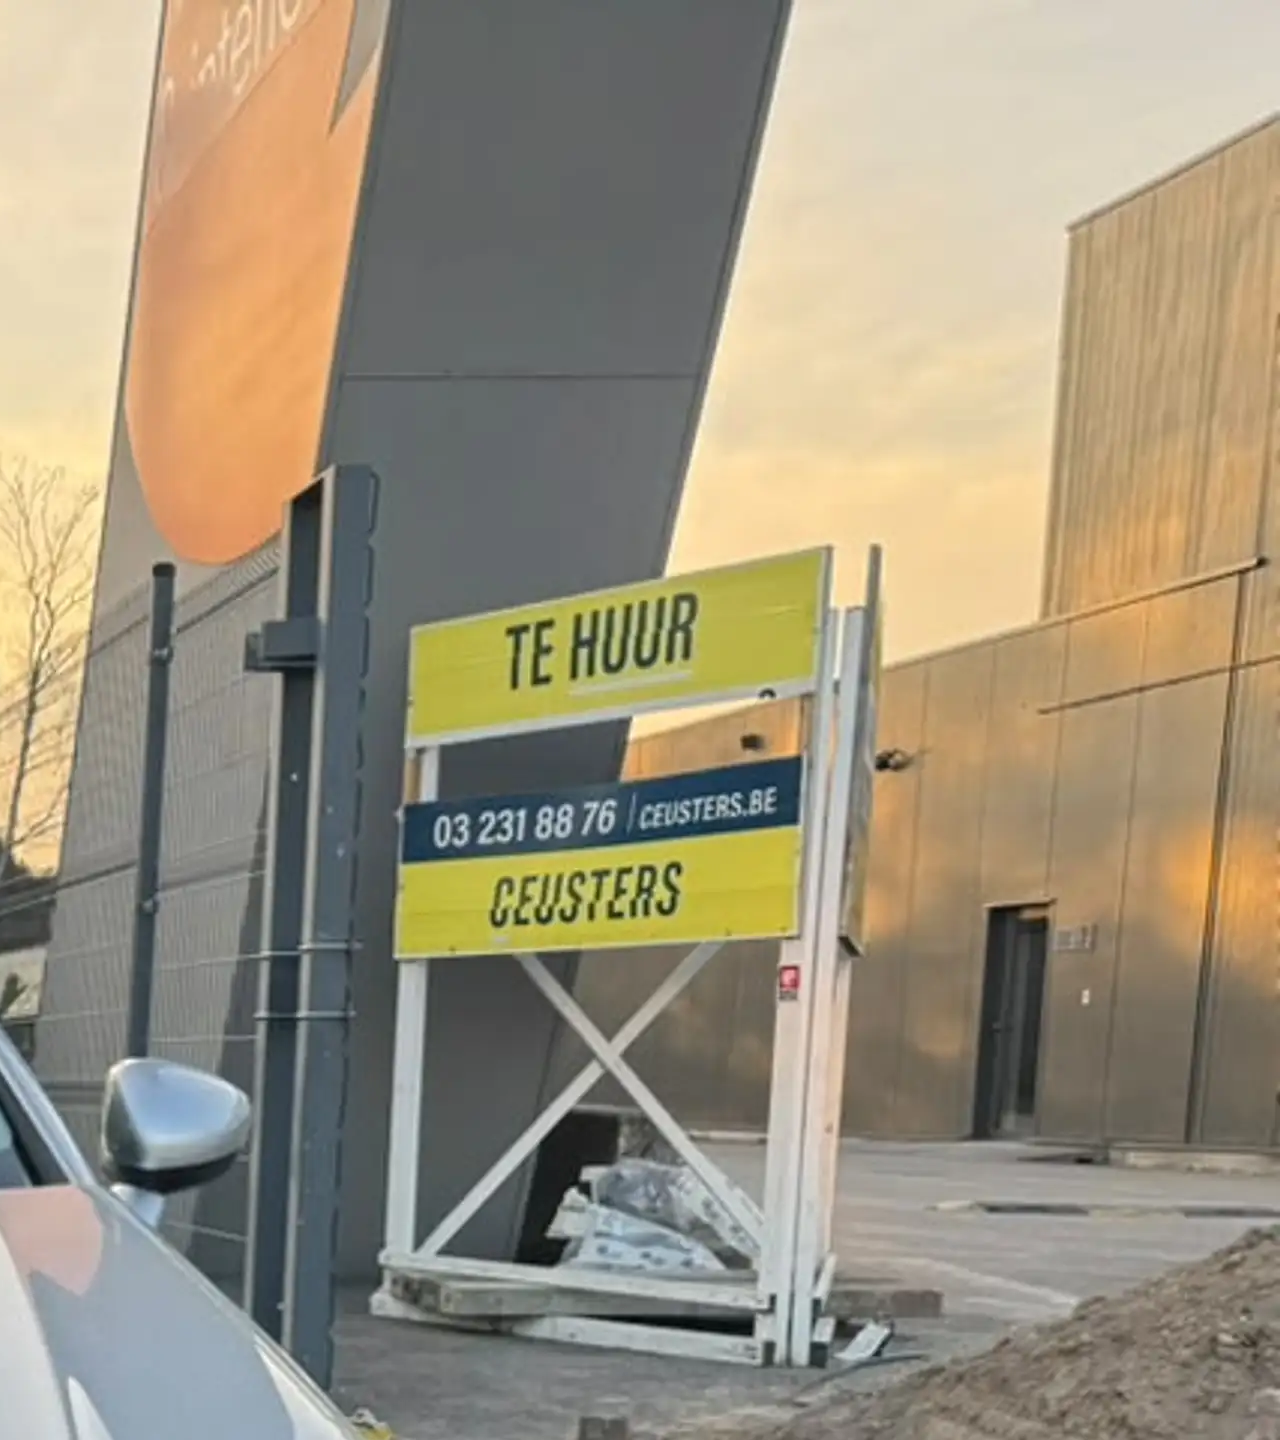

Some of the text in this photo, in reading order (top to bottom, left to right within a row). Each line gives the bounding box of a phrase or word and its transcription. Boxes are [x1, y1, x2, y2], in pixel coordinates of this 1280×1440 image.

[506, 593, 699, 690] TE HUUR
[433, 787, 779, 849] 03 231 88 76 CEUSTERS.BE
[489, 860, 683, 929] CEUSTERS
